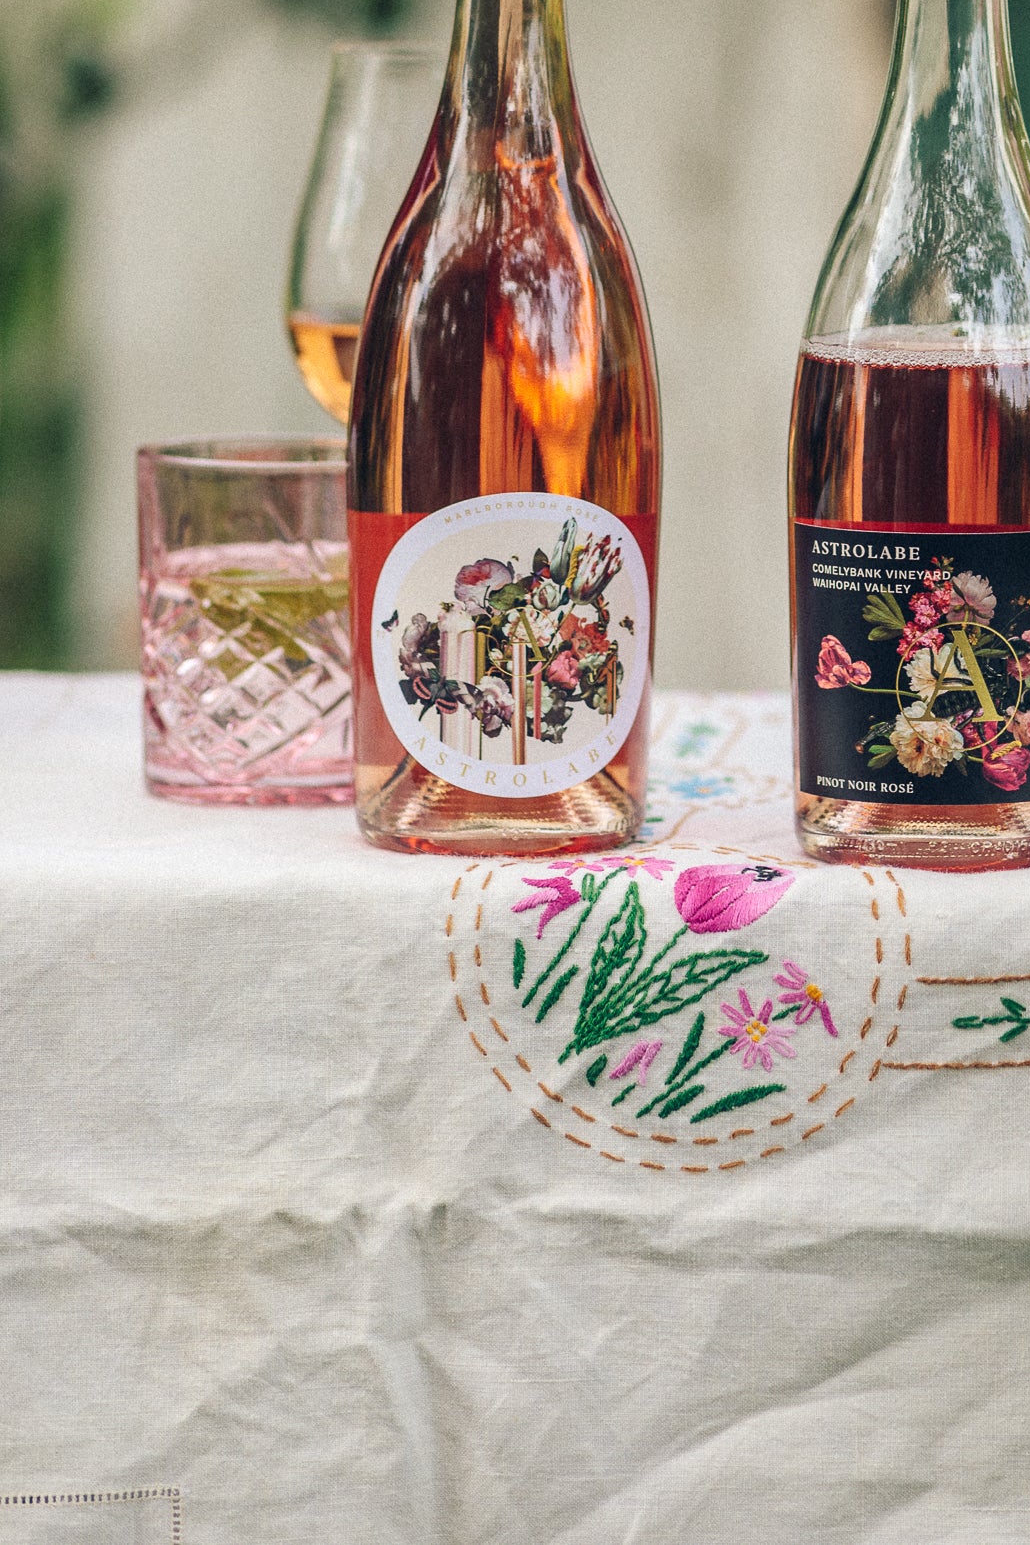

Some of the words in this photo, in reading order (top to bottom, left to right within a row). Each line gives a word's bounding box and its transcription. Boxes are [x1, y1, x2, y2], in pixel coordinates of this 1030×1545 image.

[444, 501, 557, 523] MARLBOROUGH
[812, 540, 920, 561] ASTROLABE
[812, 563, 882, 579] COMELYBANK
[885, 569, 951, 581] VINEYARD
[812, 577, 860, 591] WAIHOPAI
[864, 582, 911, 594] VALLEY
[906, 630, 1004, 721] A
[413, 729, 617, 787] ASTROLABE
[816, 775, 845, 789] PINOT
[847, 780, 877, 792] NOIR
[880, 781, 914, 794] ROSÉ
